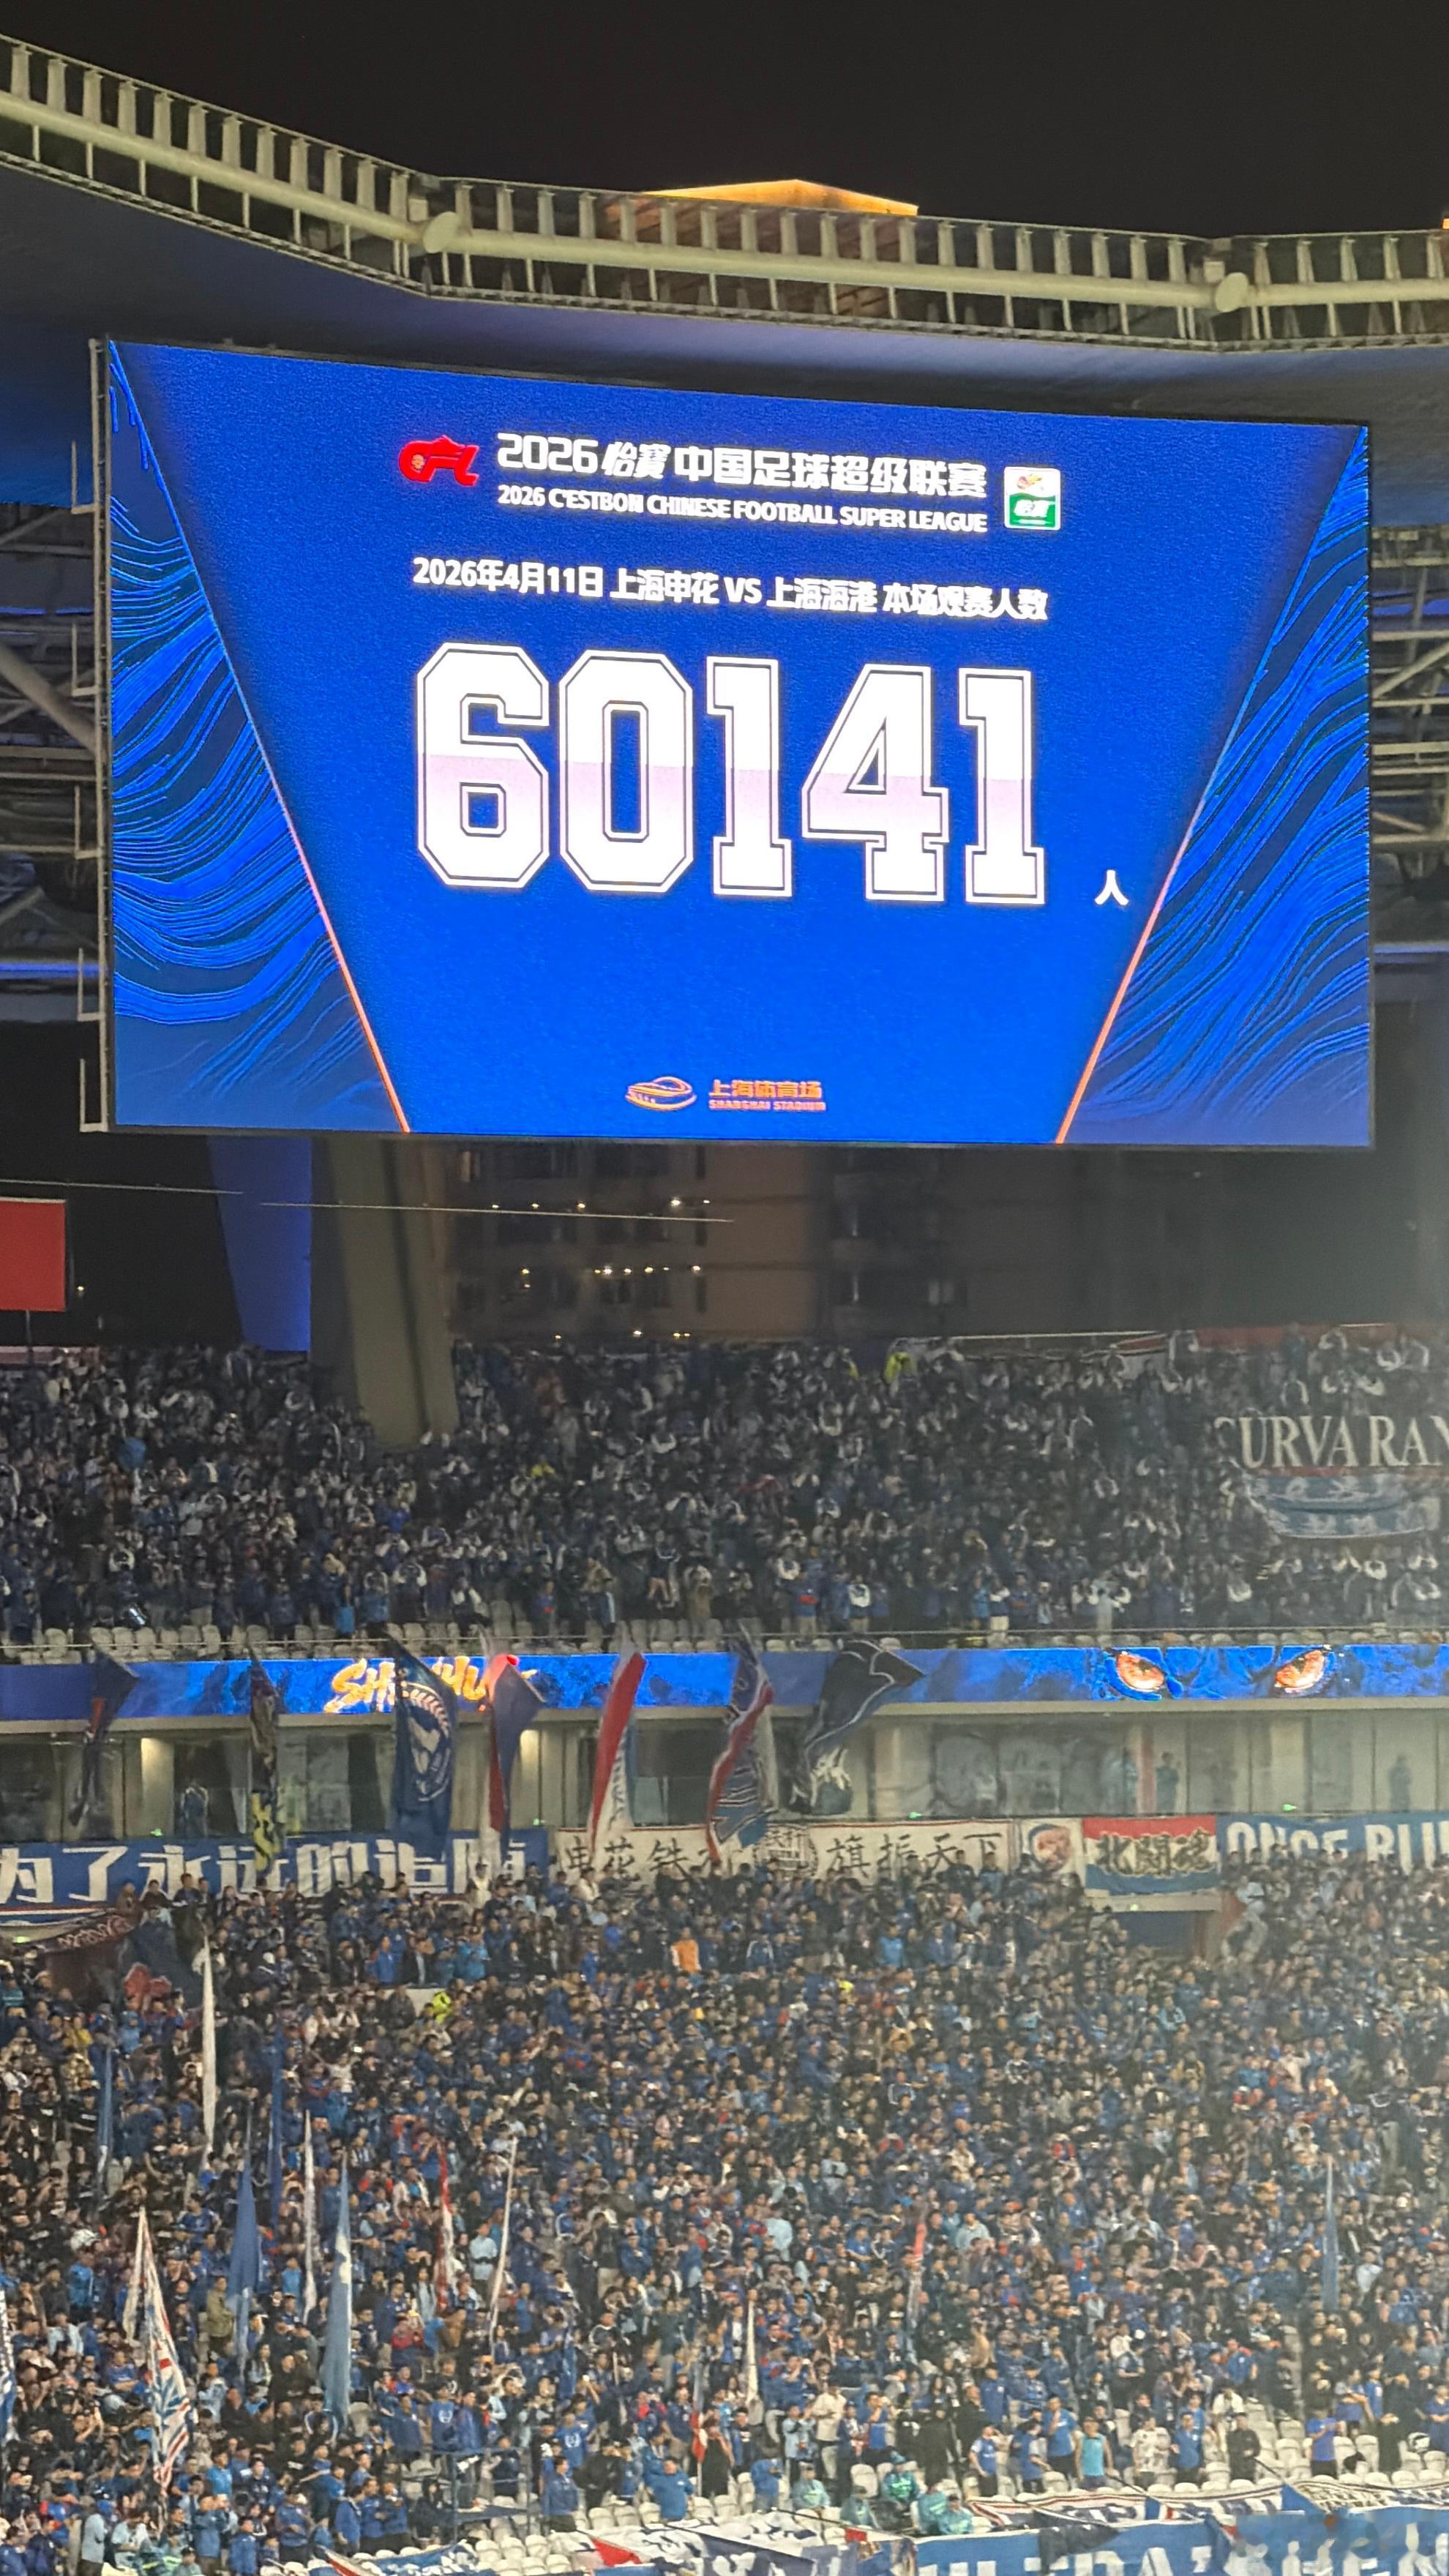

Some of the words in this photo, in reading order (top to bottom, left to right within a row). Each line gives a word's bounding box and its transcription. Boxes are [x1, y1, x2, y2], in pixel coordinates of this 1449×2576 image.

[498, 484, 545, 507] 2026
[548, 488, 645, 514] C'ESTBON
[647, 495, 732, 520] CHINESE
[733, 501, 838, 525] FOOTBALL
[840, 506, 907, 528] SUPER
[909, 510, 988, 533] LEAGUE
[413, 557, 604, 599] 2026年4月11日
[610, 568, 720, 605] 上海申花
[724, 577, 762, 606] VS
[766, 577, 878, 614] 上海海港
[882, 583, 1051, 621] 本场观赛人数
[416, 642, 1045, 905] 60141
[1094, 869, 1130, 907] 人
